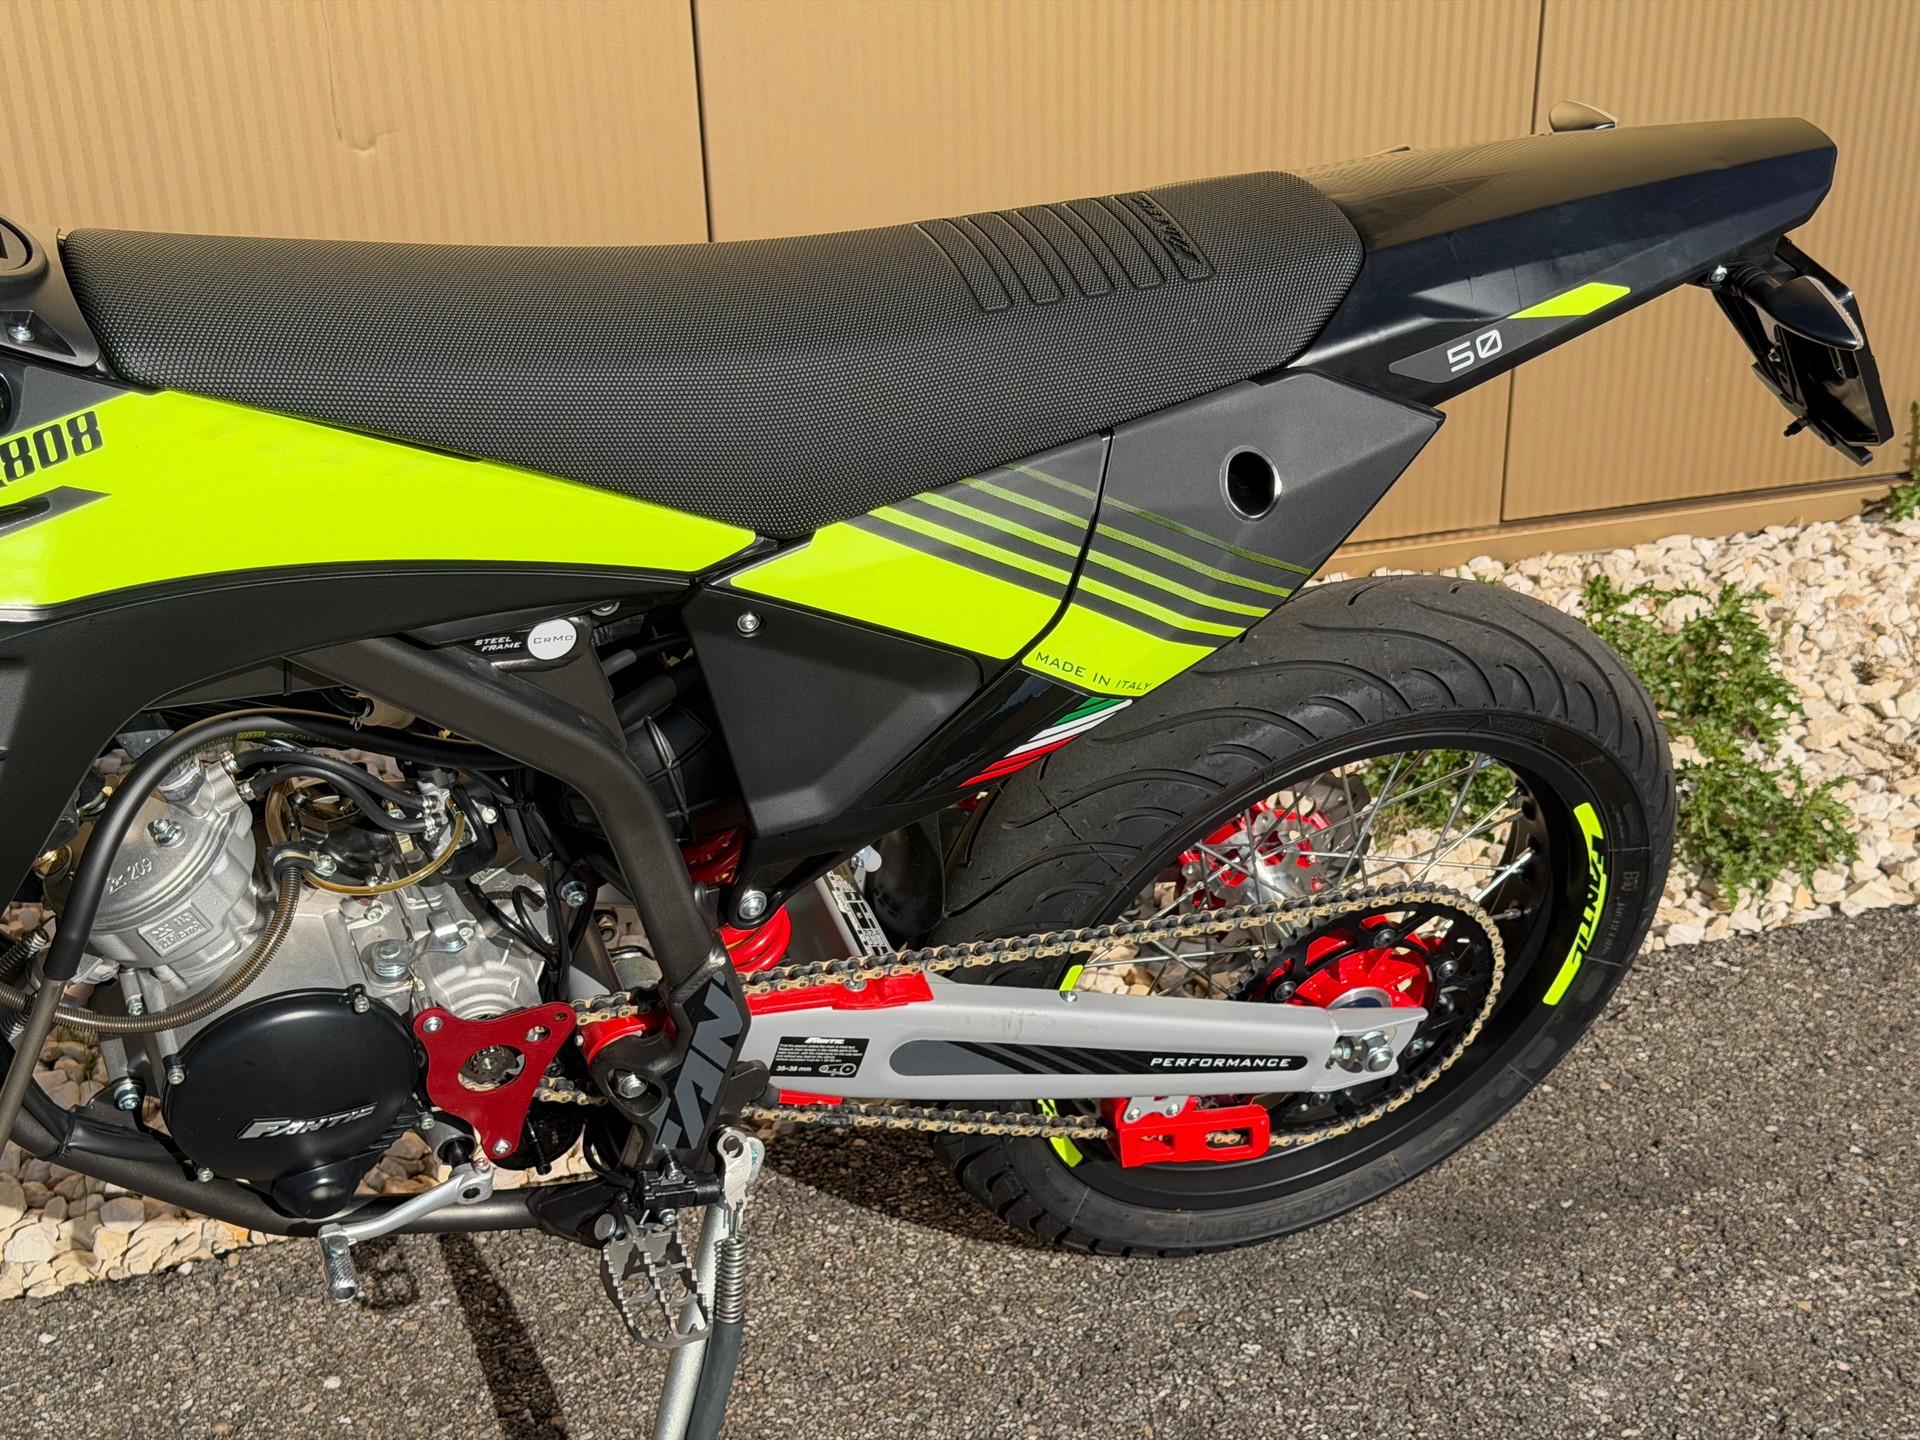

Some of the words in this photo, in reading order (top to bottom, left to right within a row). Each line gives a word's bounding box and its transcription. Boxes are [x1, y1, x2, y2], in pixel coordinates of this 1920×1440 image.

[1446, 329, 1502, 373] 50
[0, 410, 103, 489] 808
[475, 636, 512, 646] STEEL
[481, 641, 522, 652] FRAME
[1035, 652, 1086, 678] MADE
[1092, 673, 1111, 686] IN
[1115, 680, 1153, 691] ITALY
[127, 857, 153, 881] 209
[1571, 832, 1607, 965] FANTIC
[804, 1036, 845, 1045] FANTIC
[1149, 1057, 1292, 1068] PERFORMANCE
[237, 1104, 377, 1139] FANTIC
